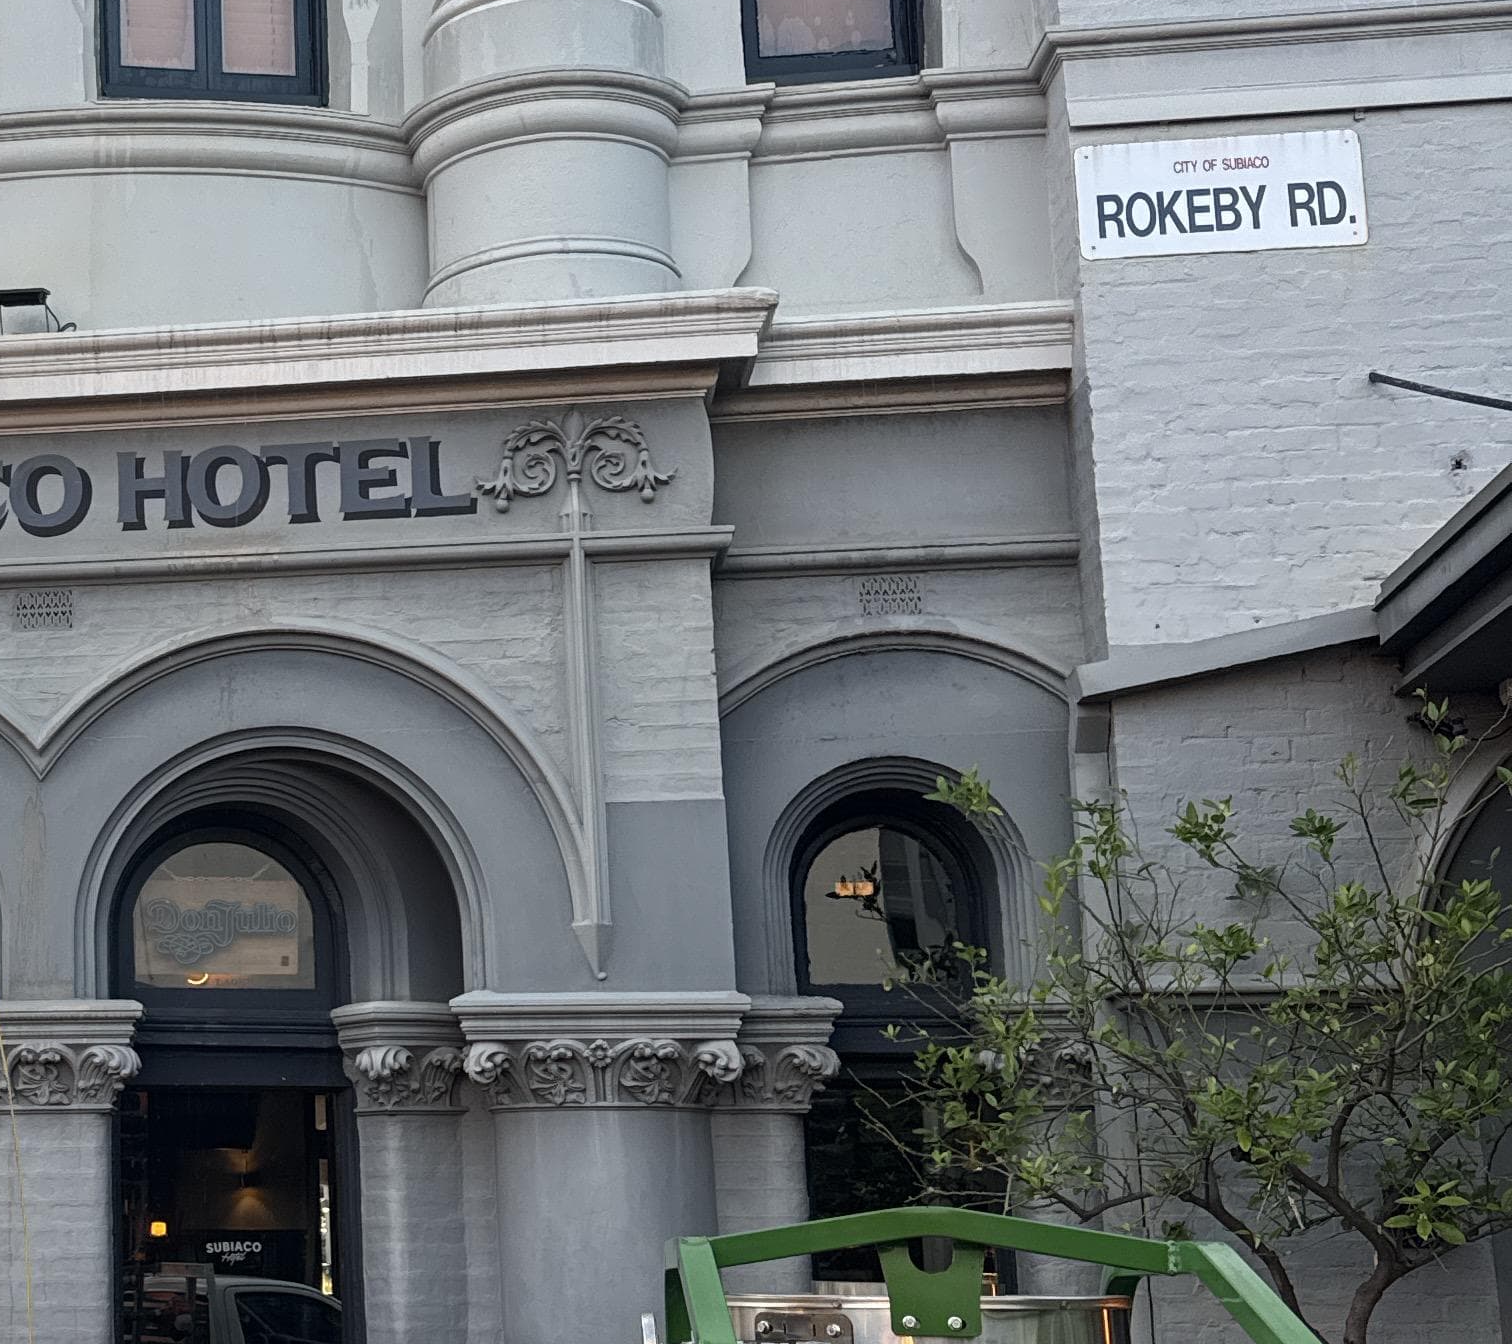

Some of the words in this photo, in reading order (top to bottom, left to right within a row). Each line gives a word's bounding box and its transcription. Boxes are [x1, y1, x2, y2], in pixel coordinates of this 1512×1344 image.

[1173, 159, 1198, 174] CITY
[1202, 158, 1218, 172] OF
[1221, 156, 1270, 171] SUBIACO
[1096, 184, 1267, 239] ROKEBY
[1288, 180, 1357, 228] RD.
[117, 436, 478, 531] HOTEL
[205, 1241, 262, 1254] SUBIACO
